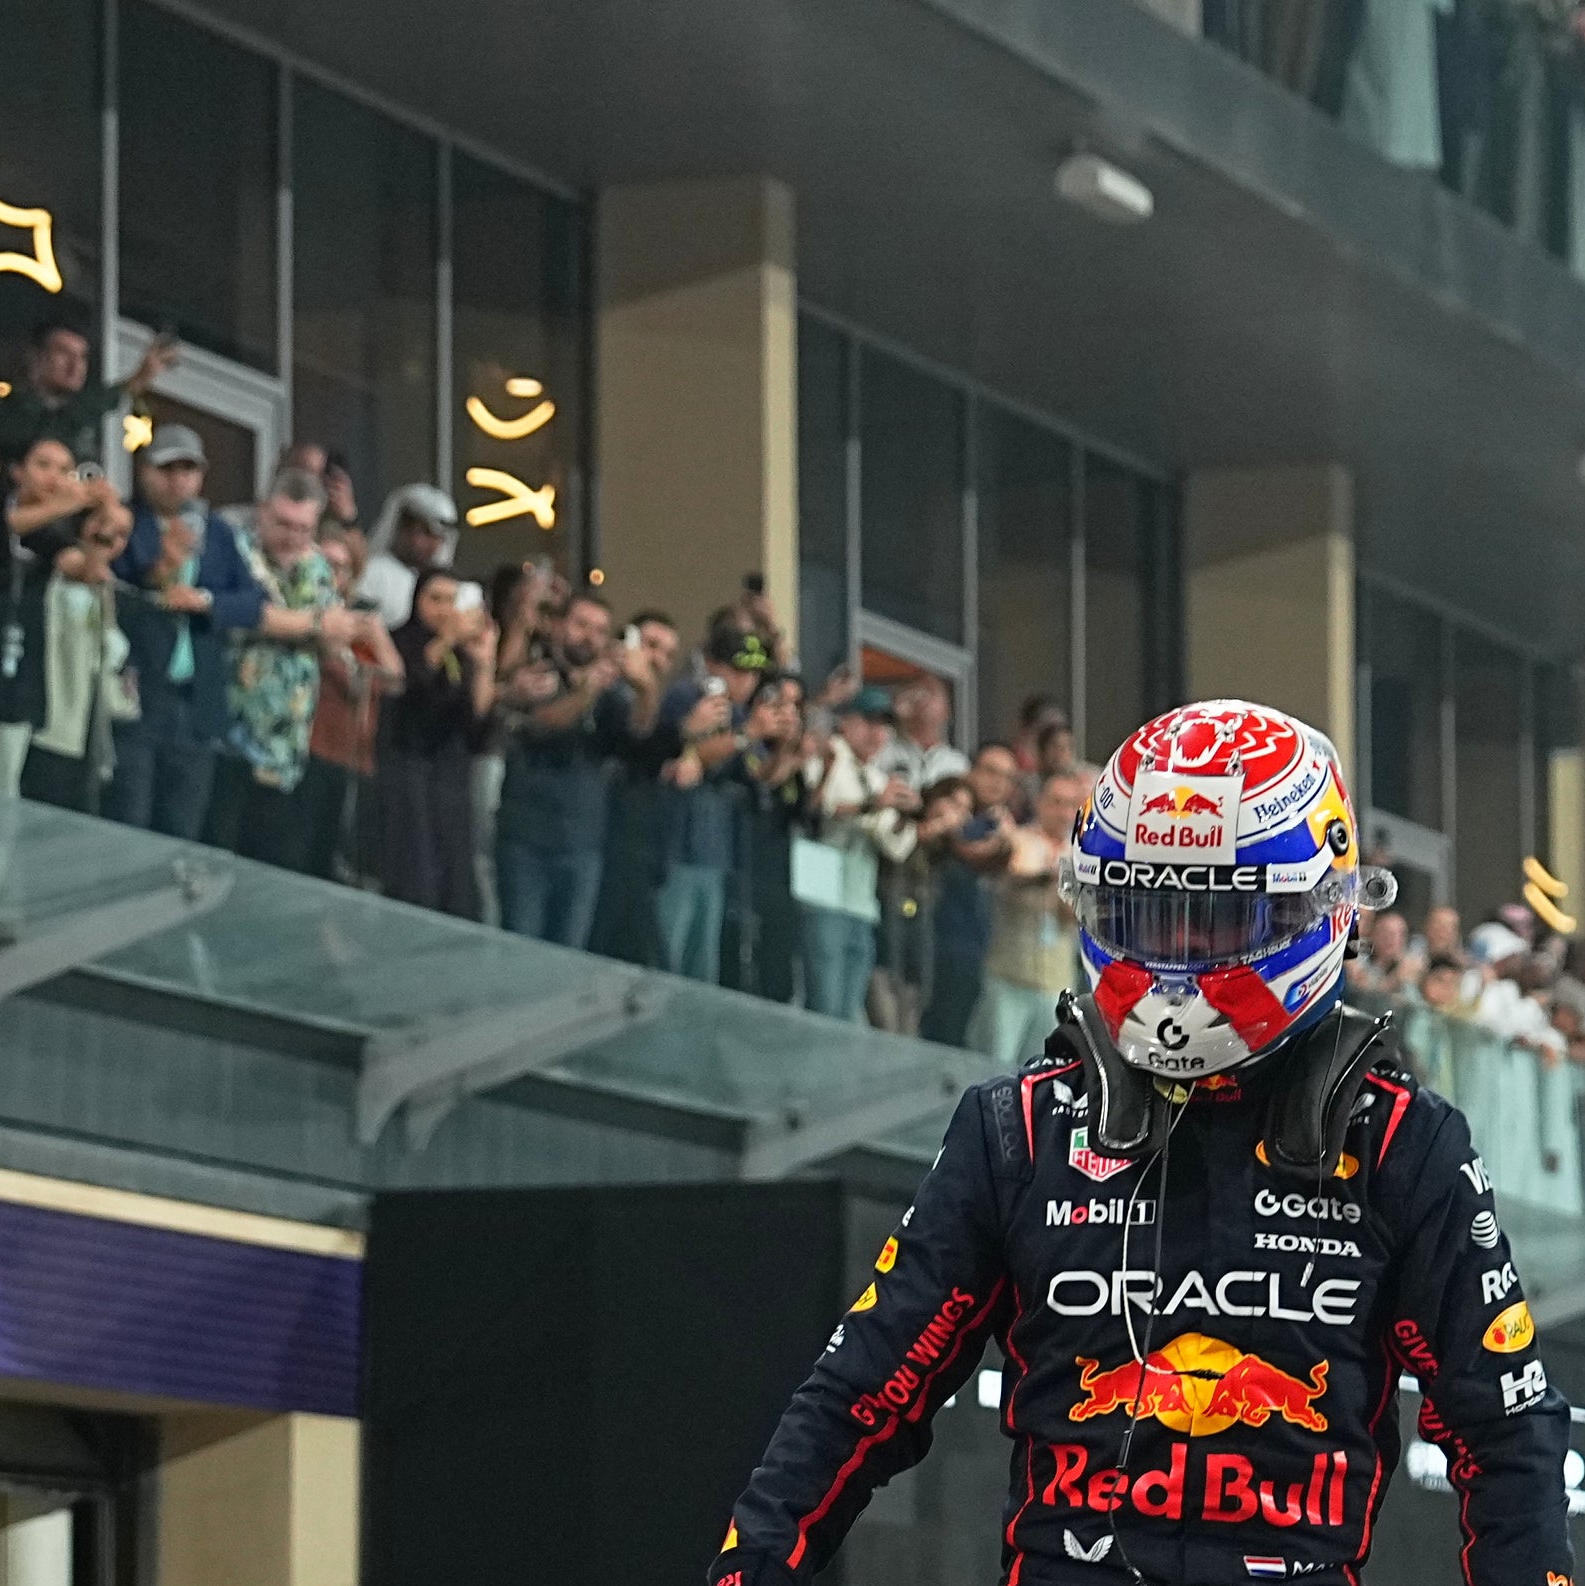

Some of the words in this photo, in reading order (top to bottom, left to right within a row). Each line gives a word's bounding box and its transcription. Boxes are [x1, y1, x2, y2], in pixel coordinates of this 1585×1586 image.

[1135, 823, 1175, 847] Red
[1179, 825, 1223, 848] Bull
[1104, 863, 1258, 891] ORACLE
[1148, 1051, 1206, 1070] Gate
[1046, 1198, 1123, 1226] Mobil
[1280, 1193, 1362, 1224] Gate
[1254, 1233, 1362, 1257] HONDA
[1046, 1270, 1362, 1325] ORACLE
[905, 1286, 975, 1367] WINGS
[1042, 1442, 1188, 1520] Red
[1201, 1450, 1349, 1527] Bull
